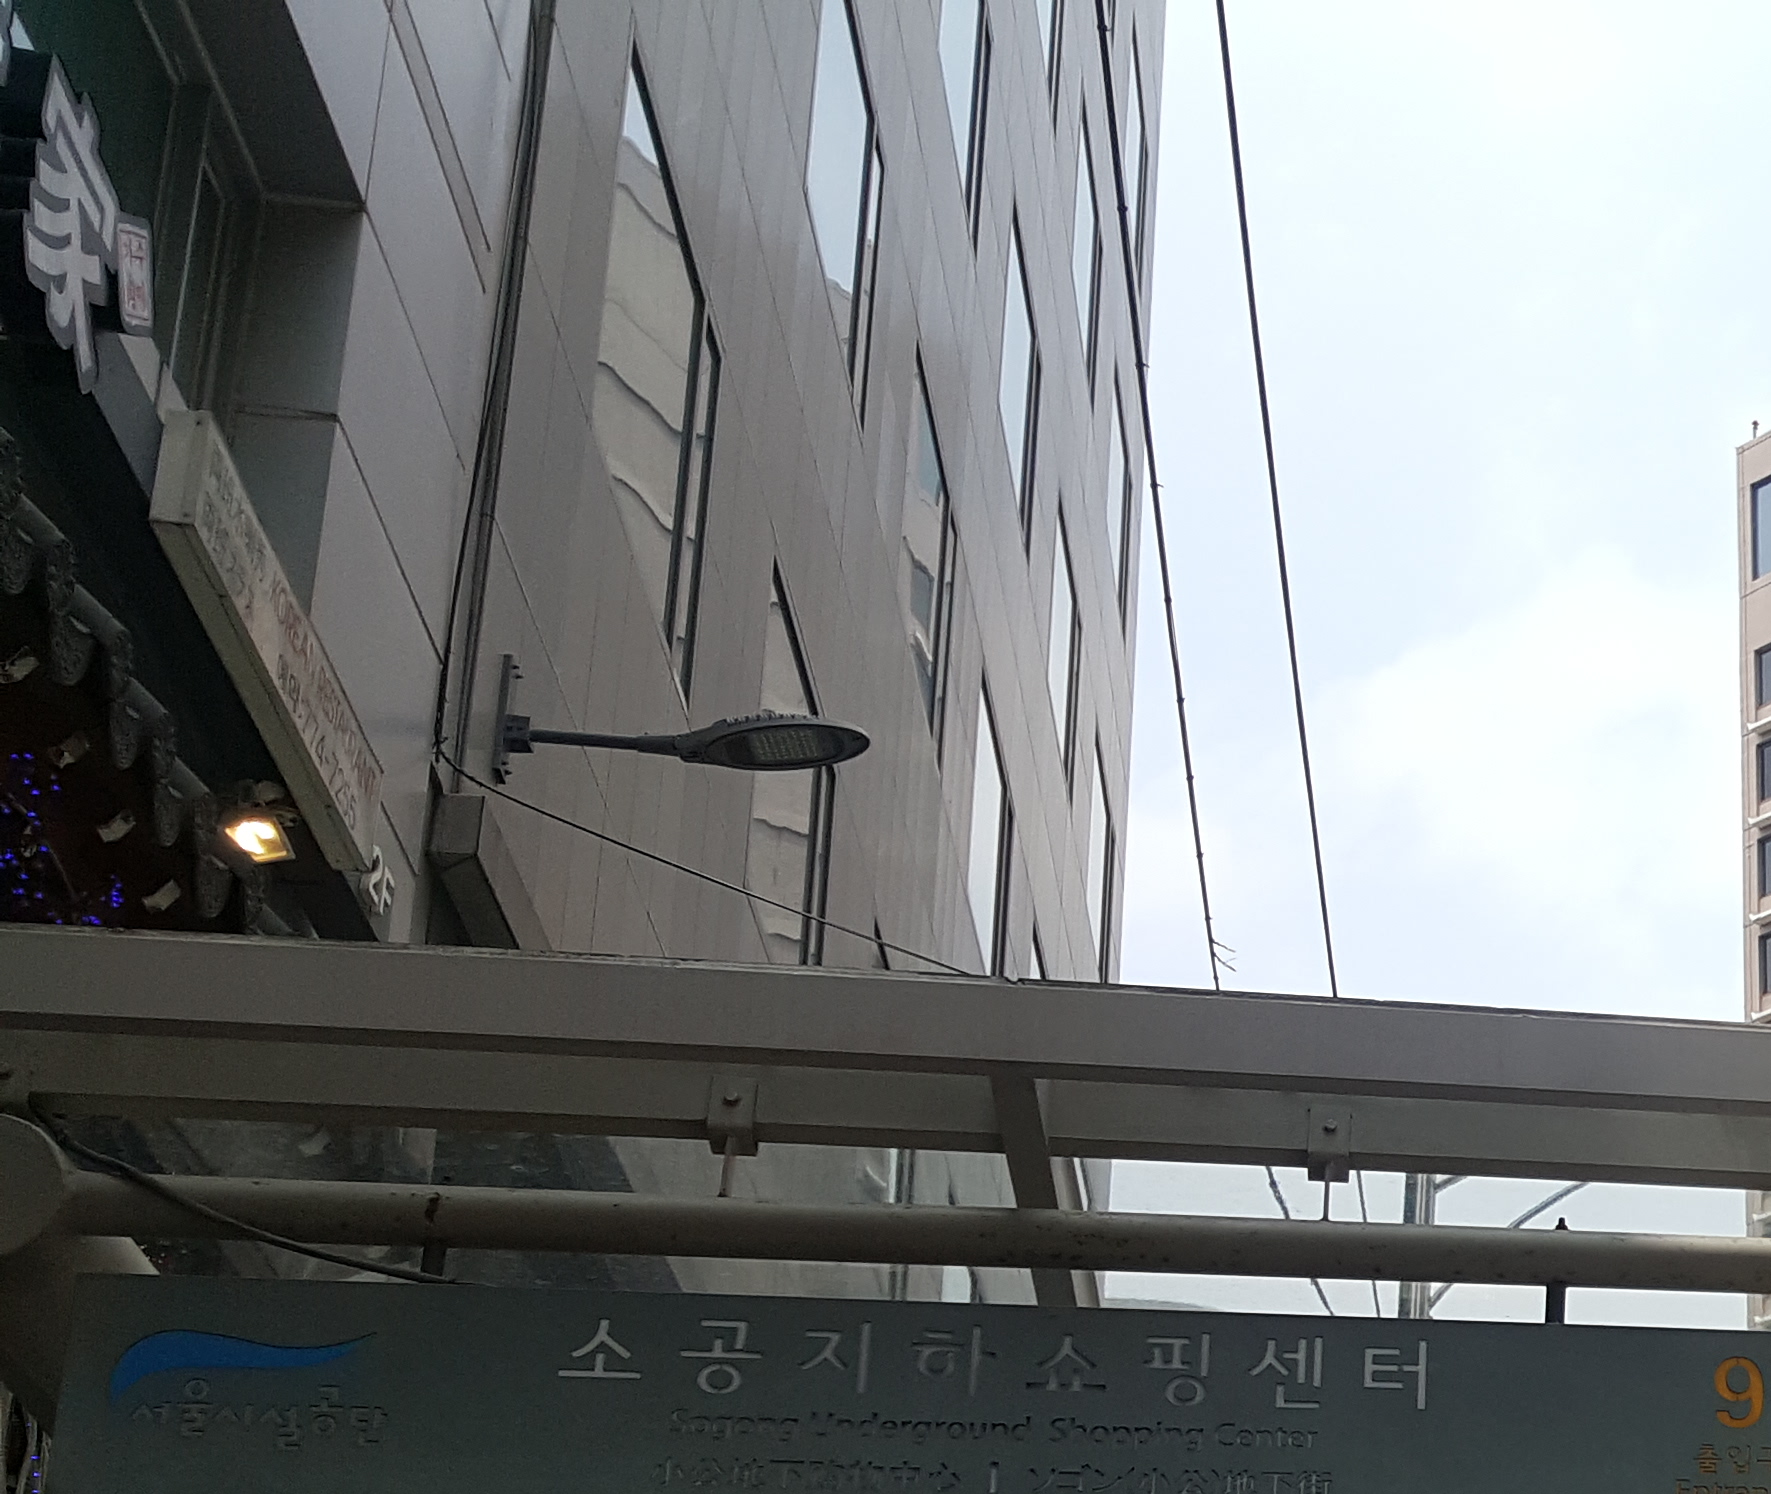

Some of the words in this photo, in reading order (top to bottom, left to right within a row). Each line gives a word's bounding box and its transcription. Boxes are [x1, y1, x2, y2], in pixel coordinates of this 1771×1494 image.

[557, 1317, 1430, 1411] 소공지하쇼핑센터
[1713, 1355, 1765, 1429] 9
[129, 1377, 390, 1452] 서울시설공단
[669, 1407, 800, 1443] Sogong
[811, 1410, 1033, 1446] Underground
[1048, 1416, 1205, 1451] Shopping
[1215, 1421, 1319, 1450] Center
